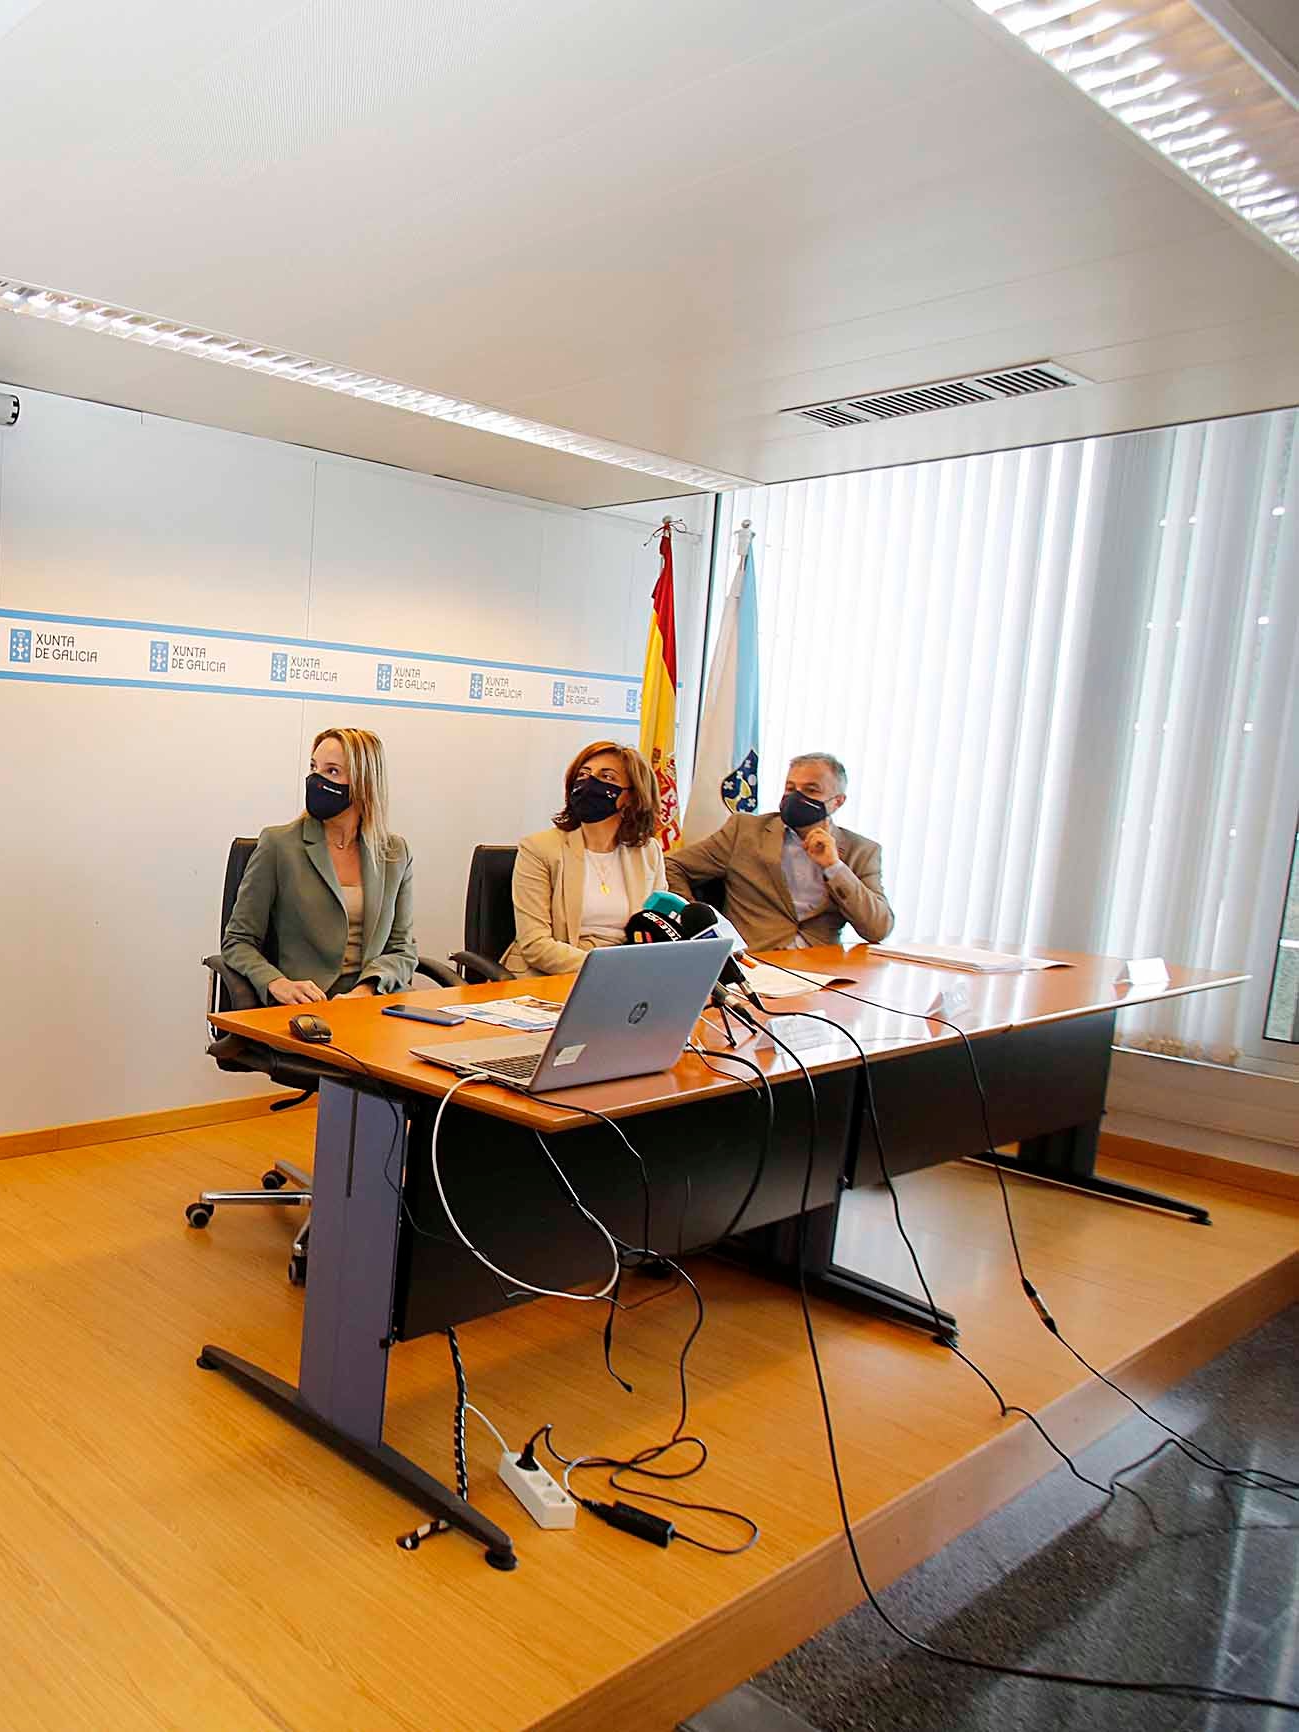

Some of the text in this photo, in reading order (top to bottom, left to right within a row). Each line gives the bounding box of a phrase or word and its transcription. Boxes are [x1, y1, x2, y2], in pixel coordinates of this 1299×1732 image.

[36, 633, 75, 648] XUNTA
[35, 647, 98, 663] DE GALICIA
[172, 644, 207, 659] XUNTA
[171, 657, 227, 673] DE GALICIA
[291, 656, 320, 669] XUNTA
[290, 668, 338, 682] DE GALICIA
[394, 667, 421, 679] XUNTA
[393, 677, 436, 693] DE GALICIA
[485, 675, 510, 687] XUNTA
[484, 686, 522, 700] DE GALICIA
